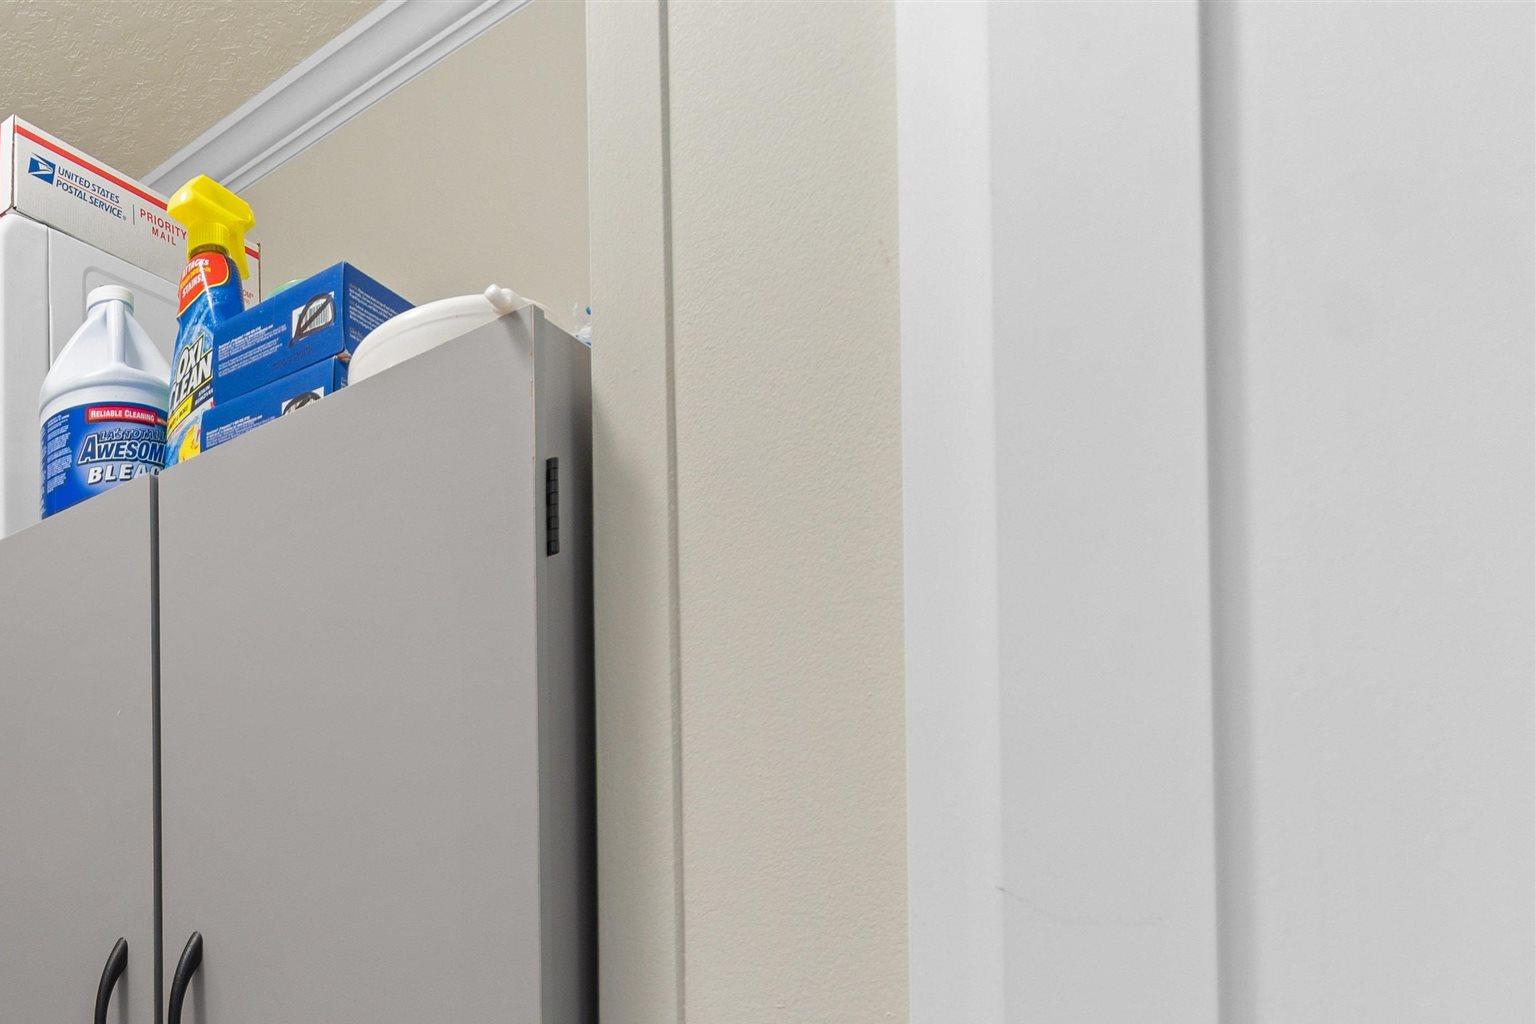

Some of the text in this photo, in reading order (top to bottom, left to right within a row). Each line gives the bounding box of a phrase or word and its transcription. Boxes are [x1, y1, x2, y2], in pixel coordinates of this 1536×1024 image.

[55, 178, 88, 202] POSTAL
[58, 166, 120, 204] UNITED STATES
[139, 207, 187, 240] PRIORITY
[151, 226, 177, 247] MAIL
[176, 333, 205, 381] OXI
[169, 349, 213, 414] CLEAN
[90, 409, 155, 421] RELIABLE CLEANING
